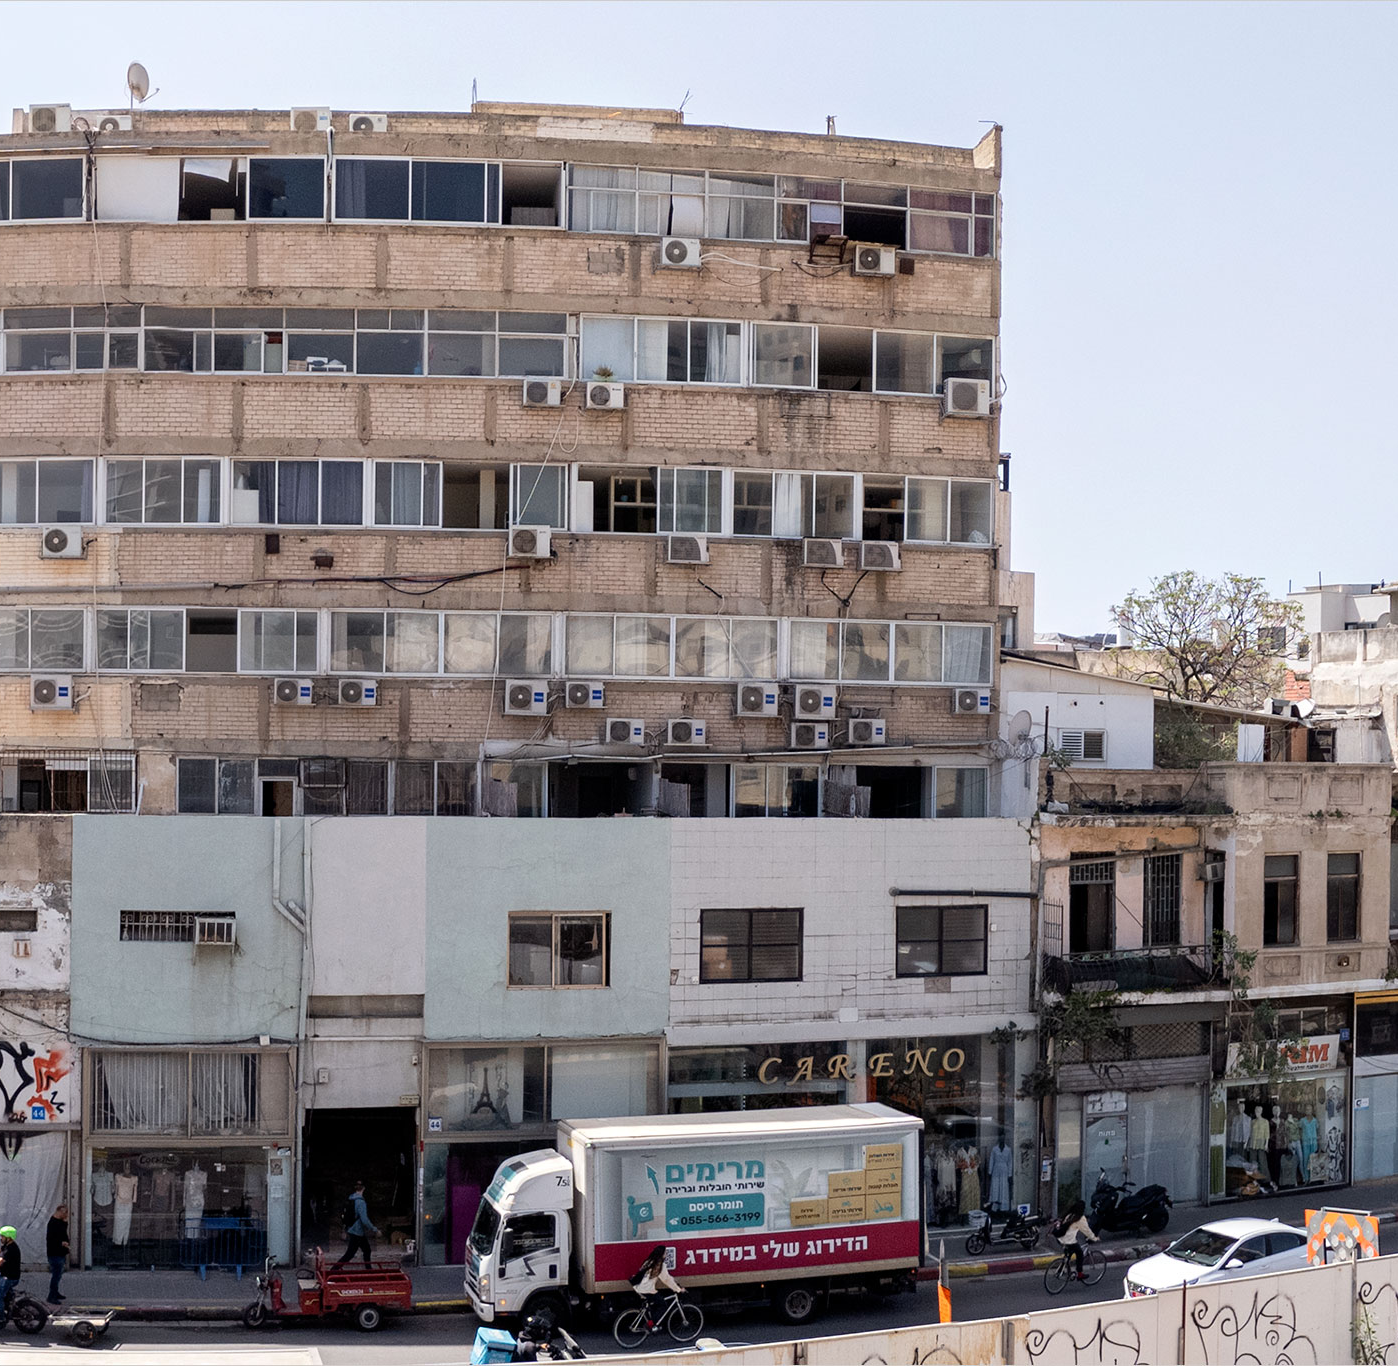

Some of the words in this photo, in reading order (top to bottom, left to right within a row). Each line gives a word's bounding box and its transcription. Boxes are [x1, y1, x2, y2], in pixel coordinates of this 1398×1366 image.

[758, 1048, 966, 1086] CARENO
[33, 1109, 45, 1118] 44
[666, 1160, 765, 1183] מרימים
[665, 1186, 696, 1194] וגרירה
[698, 1183, 732, 1192] הובלות
[735, 1182, 764, 1190] שירותי
[689, 1202, 715, 1212] סיסם
[717, 1200, 744, 1210] תומר
[681, 1211, 761, 1226] 055-566-3199
[762, 1239, 800, 1259] שלי
[805, 1235, 868, 1256] הדירוג
[684, 1245, 757, 1266] במידרג
